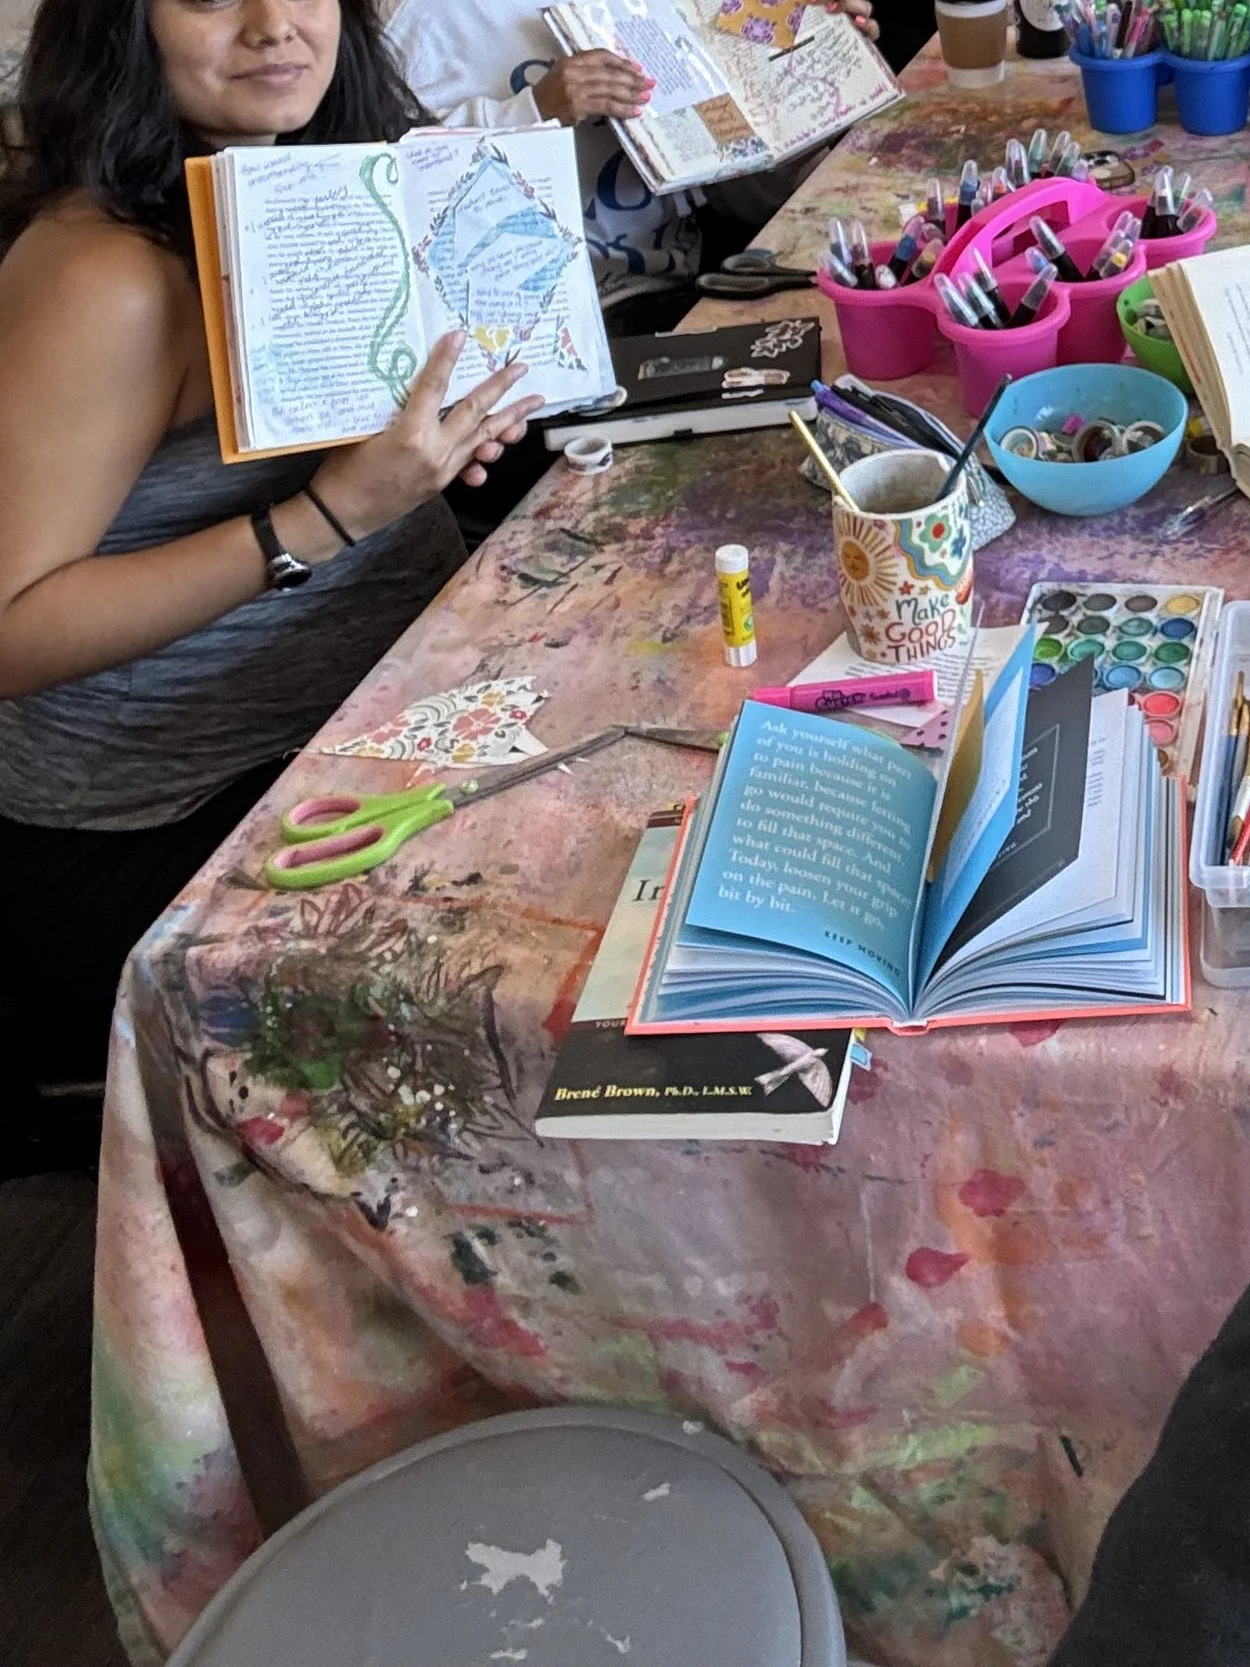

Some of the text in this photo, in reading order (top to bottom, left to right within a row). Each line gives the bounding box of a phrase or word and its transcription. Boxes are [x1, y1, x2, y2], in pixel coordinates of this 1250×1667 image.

[885, 608, 956, 644] GOOD
[895, 594, 950, 626] Make
[887, 634, 956, 664] THINGS
[756, 735, 898, 788] of you is holding on
[760, 719, 914, 780] Ask yourself what part
[753, 751, 892, 801] to pain because it is
[740, 798, 906, 868] do something different.
[743, 785, 913, 852] go would require you to
[814, 780, 868, 808] because
[871, 802, 913, 836] letting
[732, 833, 769, 851] what
[774, 842, 818, 864] could
[821, 851, 842, 870] fill
[845, 862, 873, 884] that
[737, 816, 893, 877] to fill that space. And
[718, 885, 797, 914] bit by bit.
[722, 870, 744, 883] on
[749, 873, 776, 890] the
[777, 881, 818, 902] pain.
[822, 890, 847, 911] Let
[849, 901, 861, 915] it
[729, 849, 899, 919] Today, loosen your grip
[824, 929, 901, 977] KEEP MOVING
[554, 1085, 602, 1102] Brené
[604, 1084, 661, 1099] Brown,
